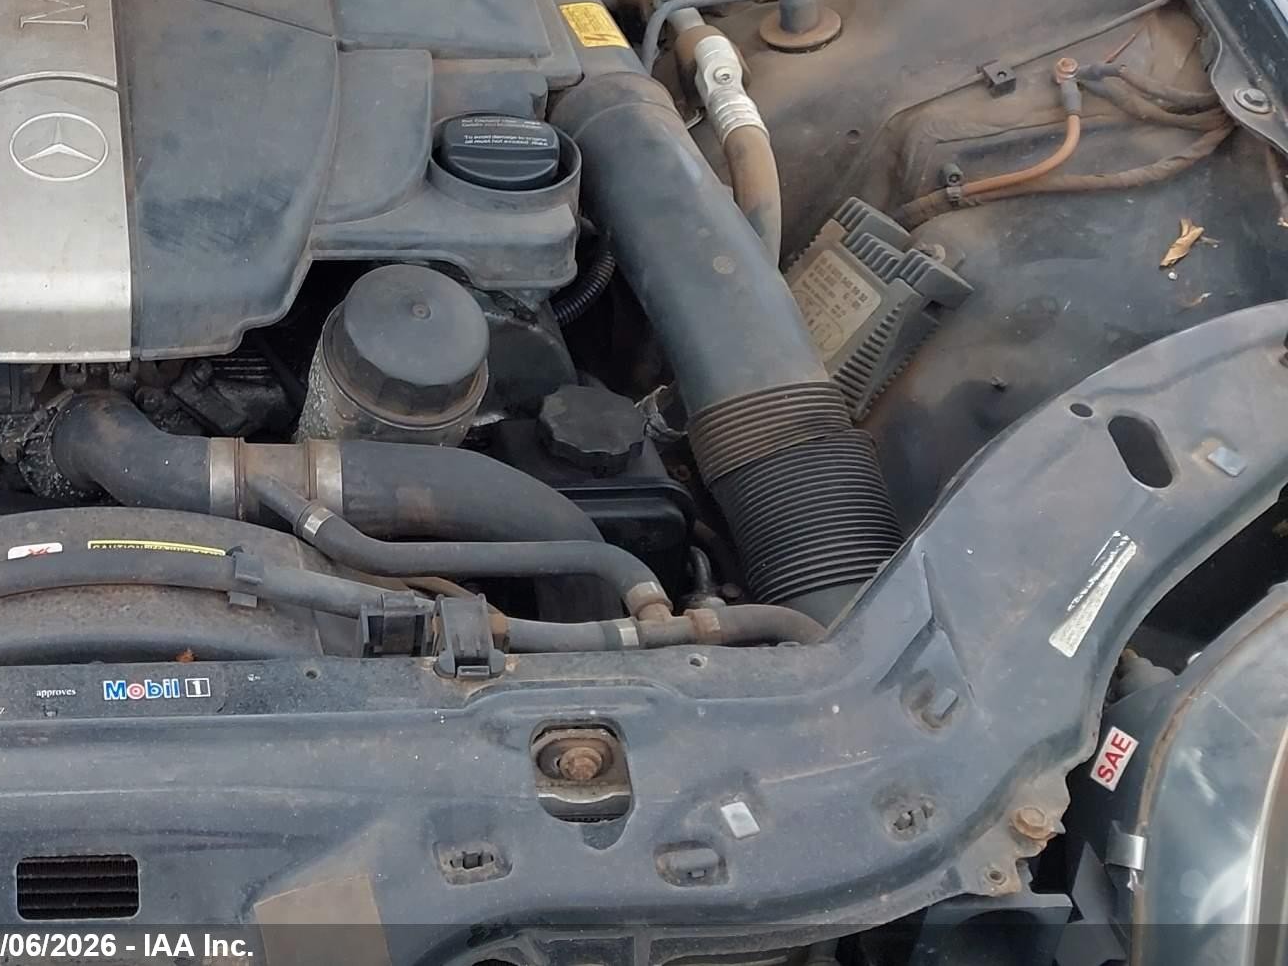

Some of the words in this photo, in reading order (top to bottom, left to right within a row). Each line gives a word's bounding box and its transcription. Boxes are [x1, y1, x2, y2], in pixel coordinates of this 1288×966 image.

[36, 687, 76, 697] approves
[103, 679, 180, 701] Mobil
[1097, 733, 1132, 783] SAE
